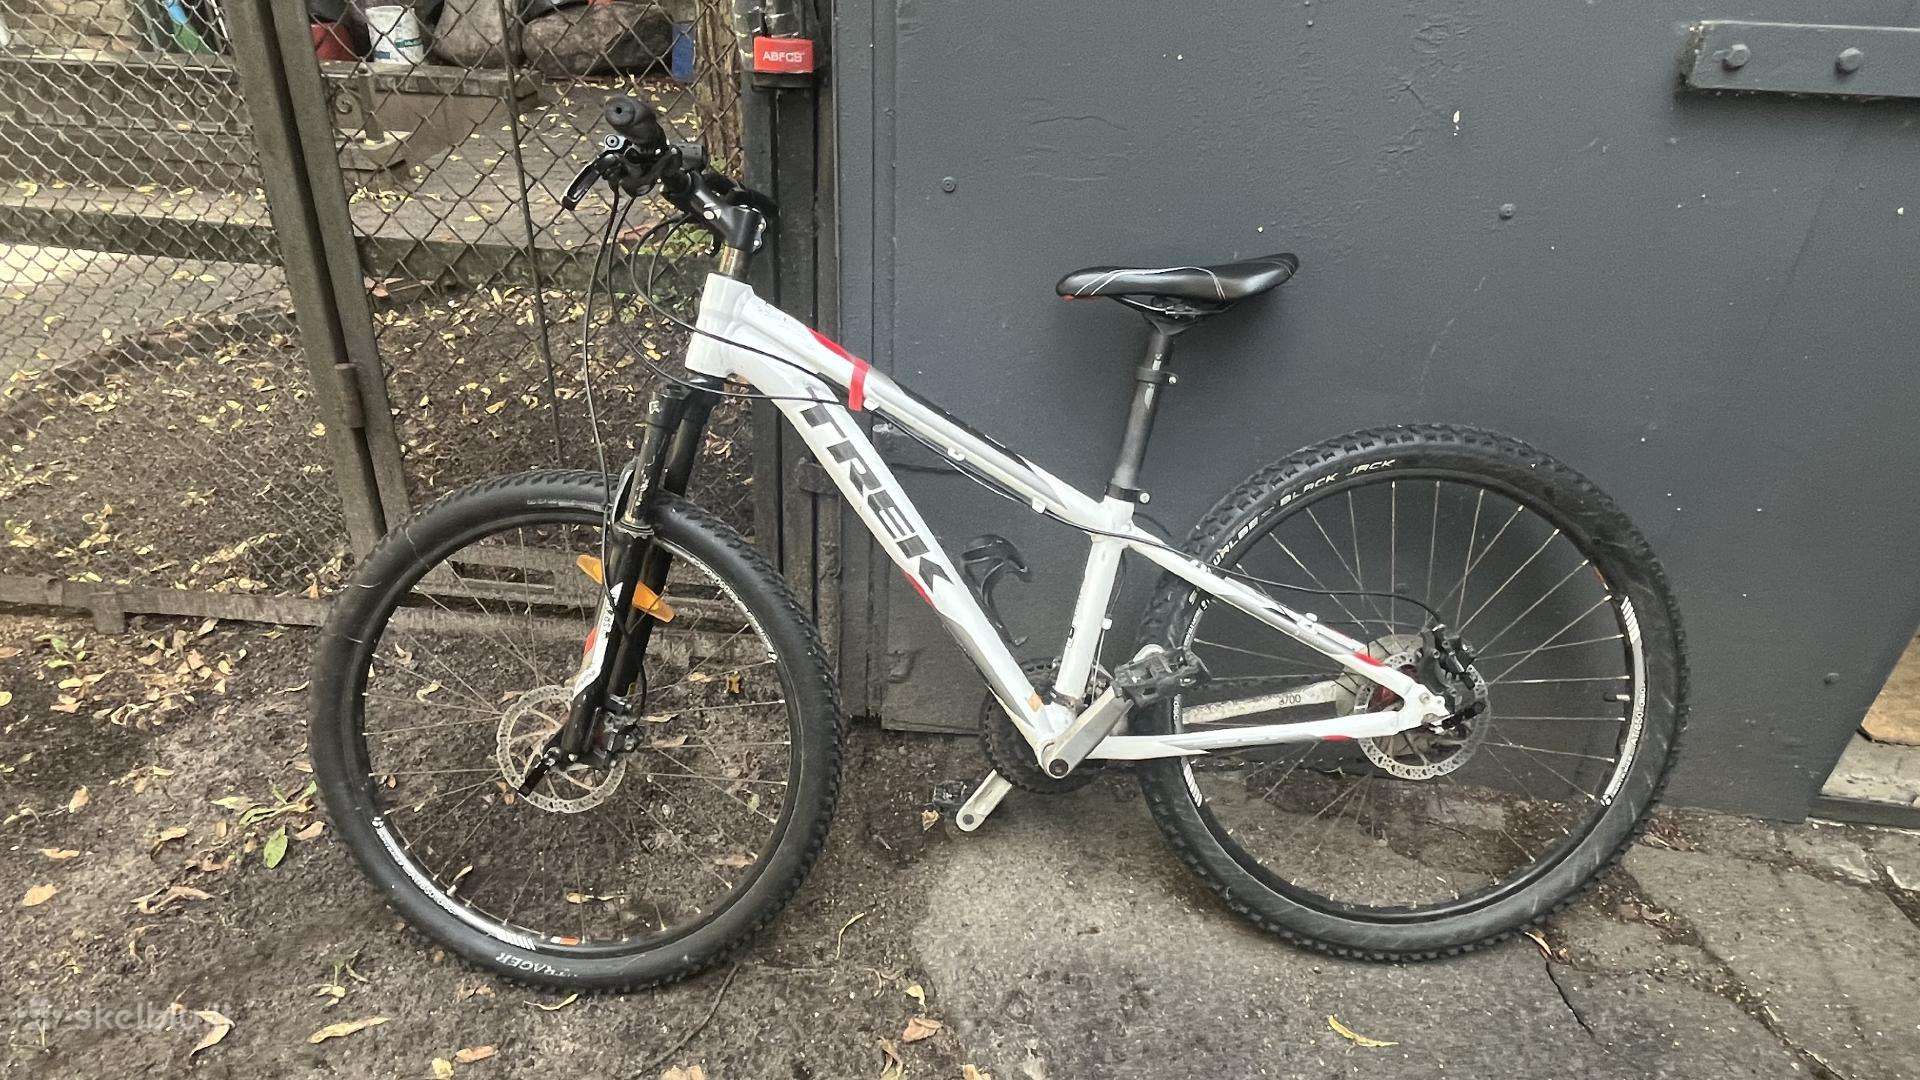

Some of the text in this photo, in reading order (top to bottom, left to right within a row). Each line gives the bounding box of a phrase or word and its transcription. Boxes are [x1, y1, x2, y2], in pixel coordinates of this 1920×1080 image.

[801, 385, 954, 592] TREK
[1280, 473, 1339, 506] BLACK
[1345, 459, 1396, 476] JACK
